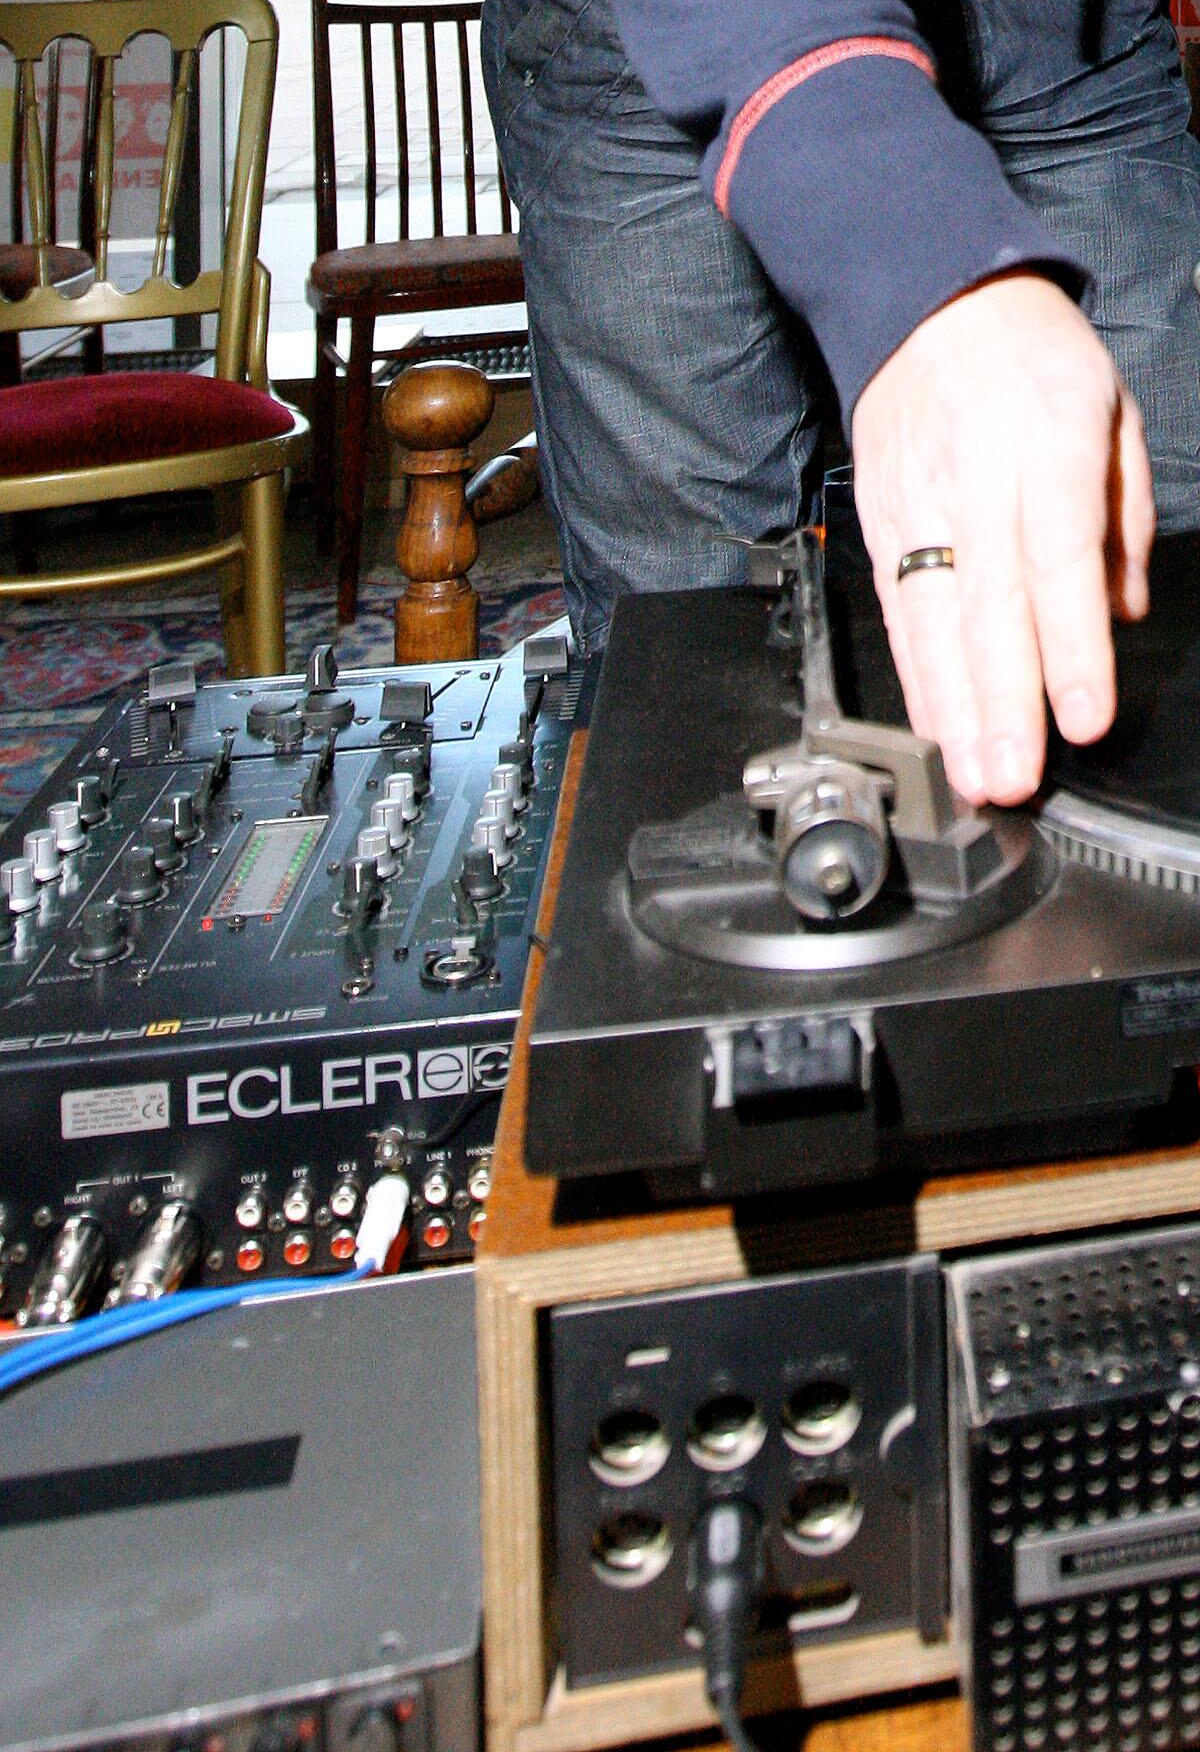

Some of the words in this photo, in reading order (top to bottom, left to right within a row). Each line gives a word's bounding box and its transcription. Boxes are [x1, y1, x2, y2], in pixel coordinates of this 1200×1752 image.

[187, 1054, 412, 1126] ECLER
[426, 1151, 446, 1163] LINE
[240, 1174, 260, 1184] OUT
[162, 1184, 184, 1194] LEFT
